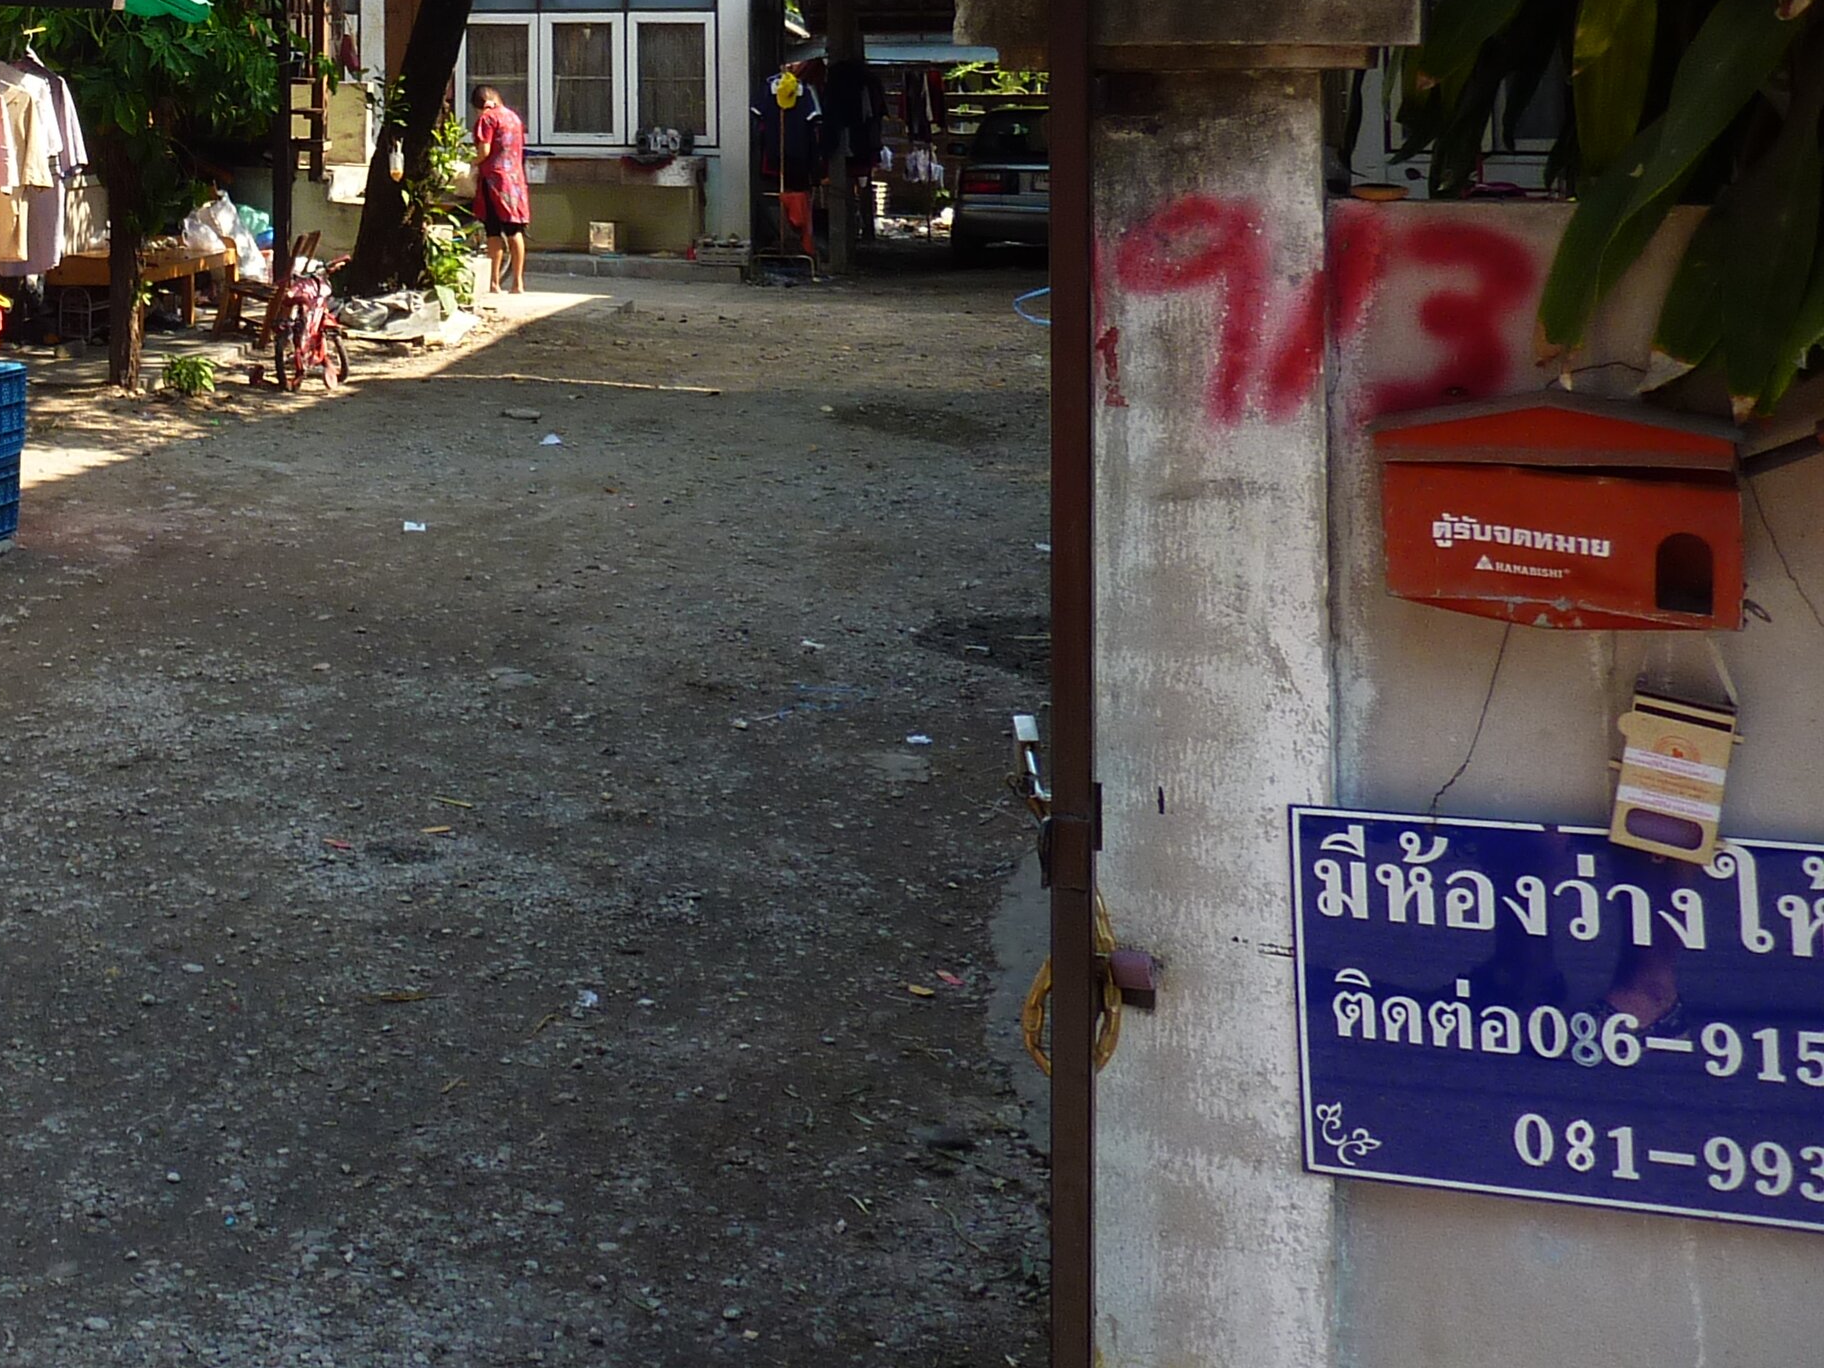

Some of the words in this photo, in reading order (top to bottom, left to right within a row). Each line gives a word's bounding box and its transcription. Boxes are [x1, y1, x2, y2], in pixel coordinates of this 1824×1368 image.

[1432, 513, 1611, 558] ตู้รับจดหมาย
